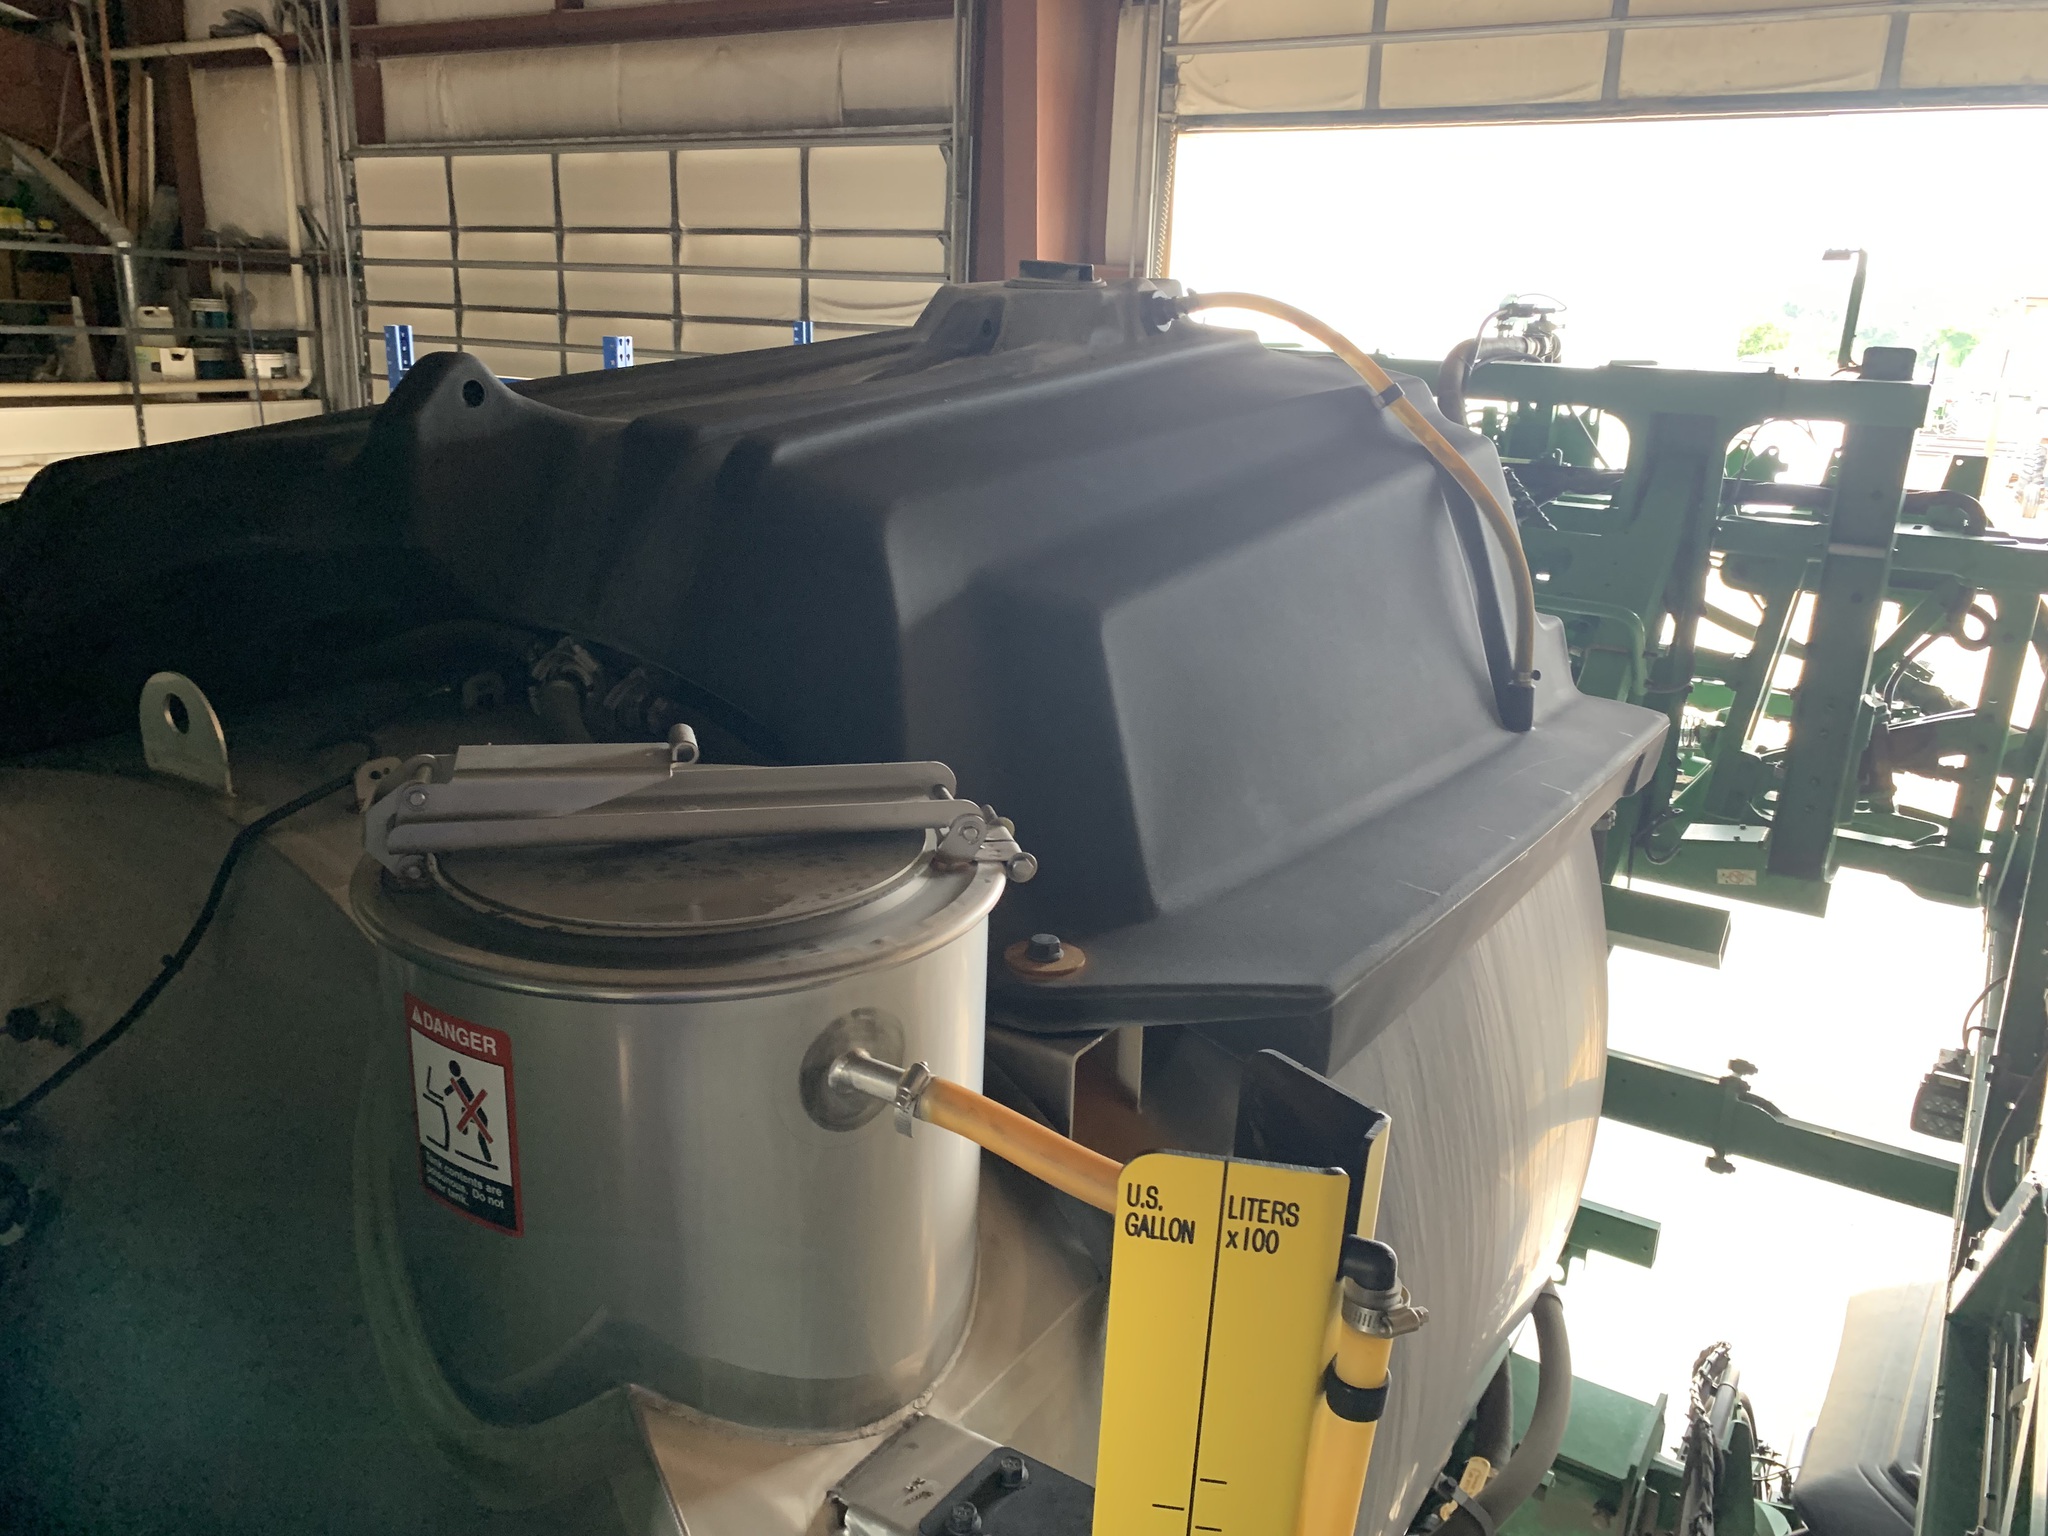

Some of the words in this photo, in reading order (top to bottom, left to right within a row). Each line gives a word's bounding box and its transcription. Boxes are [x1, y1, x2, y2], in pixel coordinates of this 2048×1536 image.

[423, 1010, 497, 1056] DANGER
[443, 1164, 483, 1190] contents
[485, 1184, 502, 1197] are
[1126, 1182, 1163, 1211] U.S.
[471, 1187, 486, 1202] Do
[487, 1196, 505, 1209] not
[1227, 1195, 1300, 1228] LITERS
[1124, 1212, 1196, 1245] GALLON
[1225, 1227, 1280, 1255] x100
